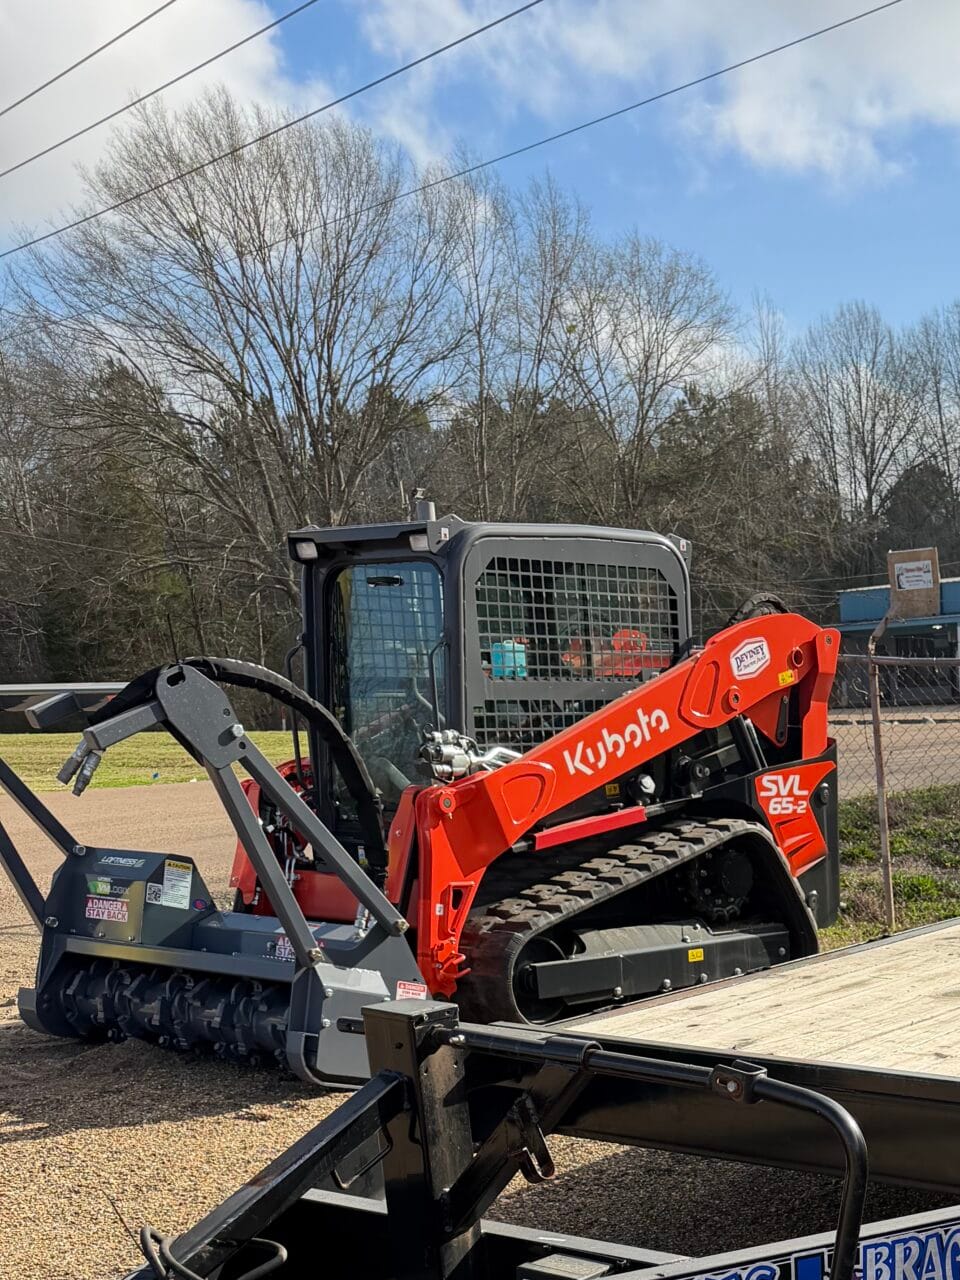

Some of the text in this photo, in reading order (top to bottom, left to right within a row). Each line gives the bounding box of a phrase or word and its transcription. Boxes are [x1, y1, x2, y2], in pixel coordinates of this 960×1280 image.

[563, 707, 671, 776] Kubota
[760, 775, 809, 797] SVL
[768, 797, 808, 815] 65-2
[93, 899, 122, 911] DANGER
[87, 908, 127, 921] STAY BACK
